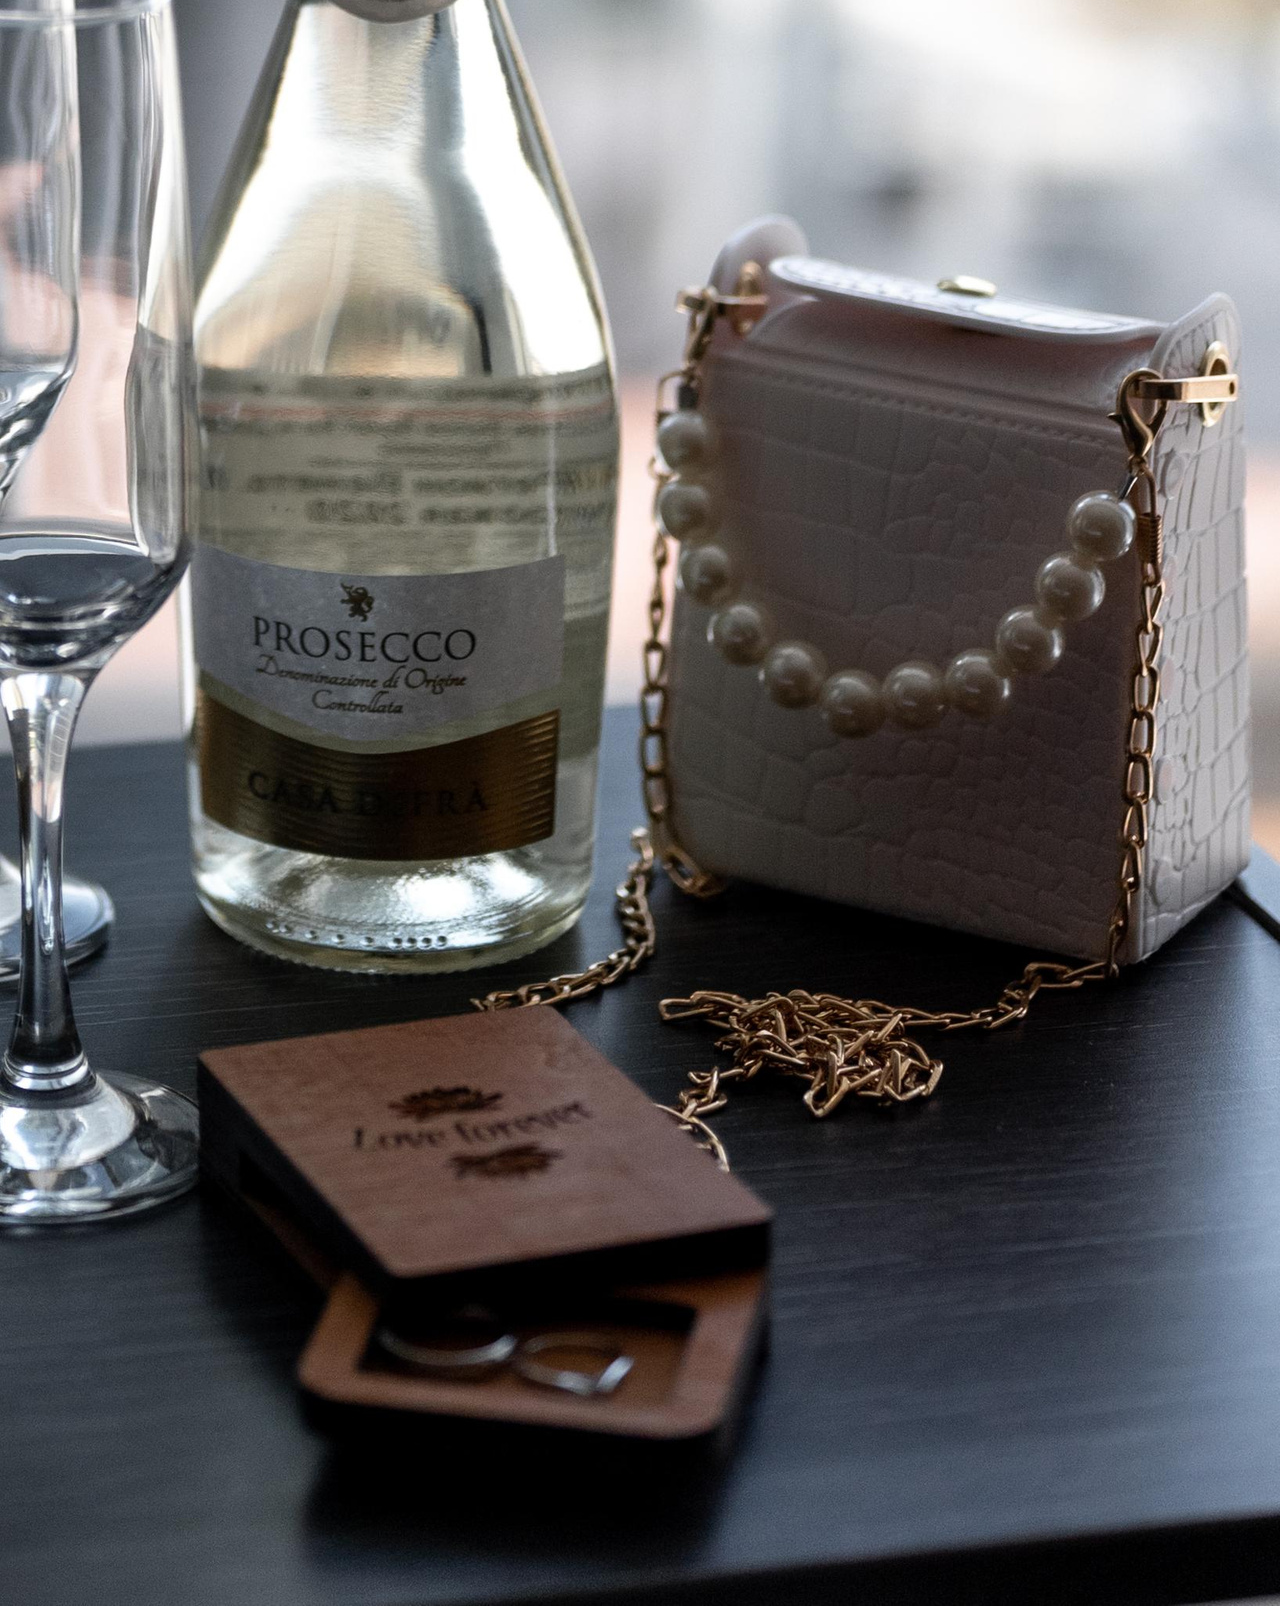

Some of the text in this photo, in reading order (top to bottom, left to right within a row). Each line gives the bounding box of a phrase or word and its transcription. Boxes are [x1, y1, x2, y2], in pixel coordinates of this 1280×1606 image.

[253, 616, 476, 663] PROSECCO
[256, 654, 467, 695] Denominazione di Origine
[312, 689, 404, 714] Controllata
[247, 770, 340, 814] CASA
[353, 1127, 446, 1149] Love
